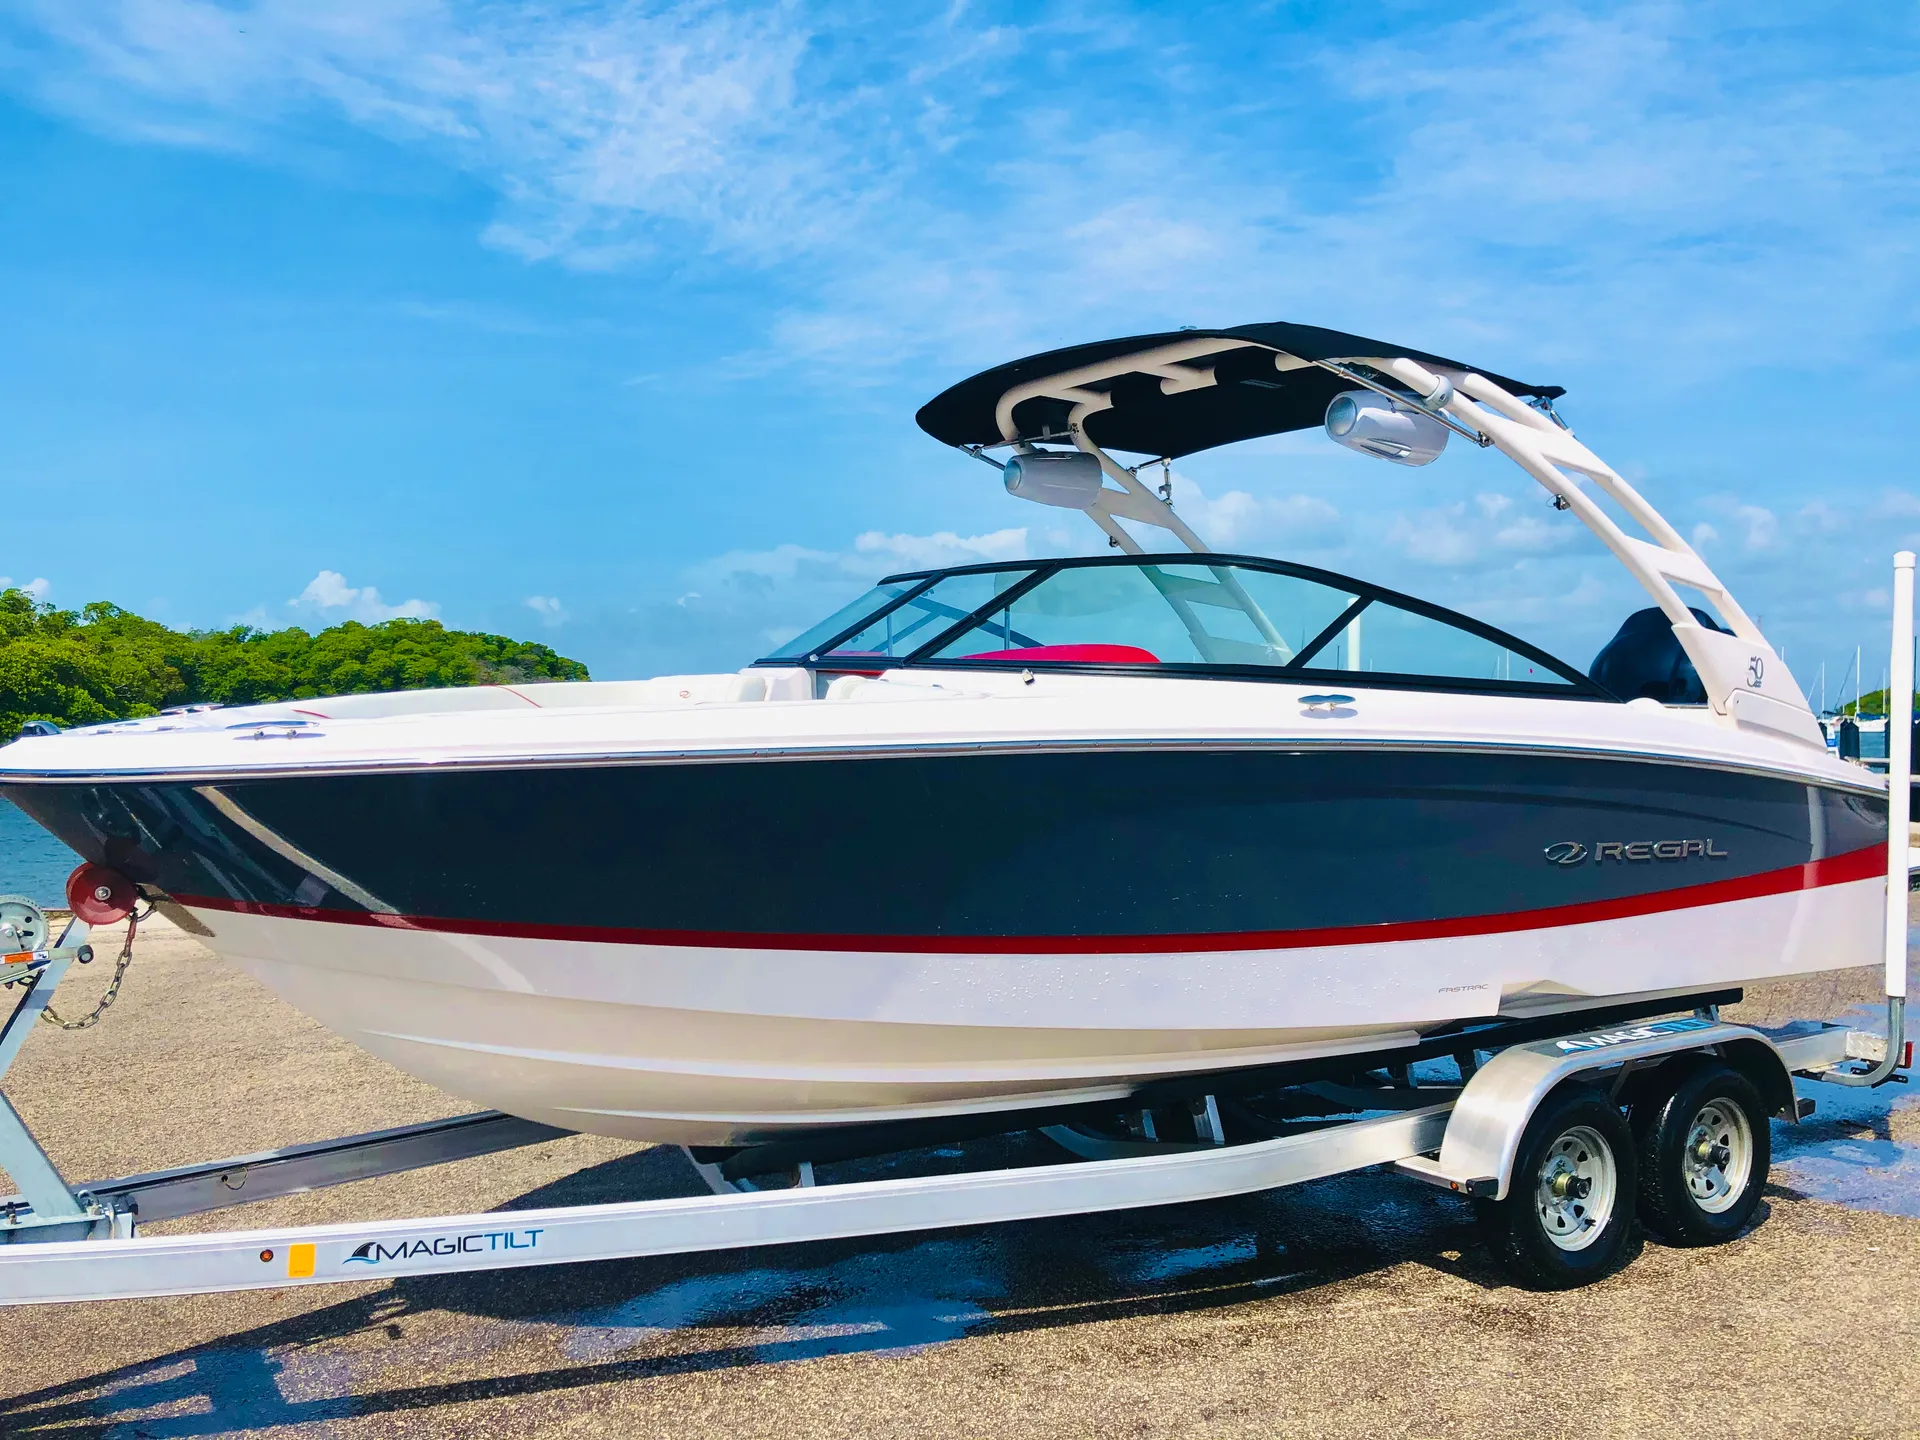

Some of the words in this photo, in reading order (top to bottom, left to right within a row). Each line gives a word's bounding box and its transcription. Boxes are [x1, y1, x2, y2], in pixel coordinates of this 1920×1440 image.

[1595, 838, 1728, 861] REGAL
[1438, 984, 1489, 993] FASTRAC
[376, 1229, 544, 1261] MAGICTILT
